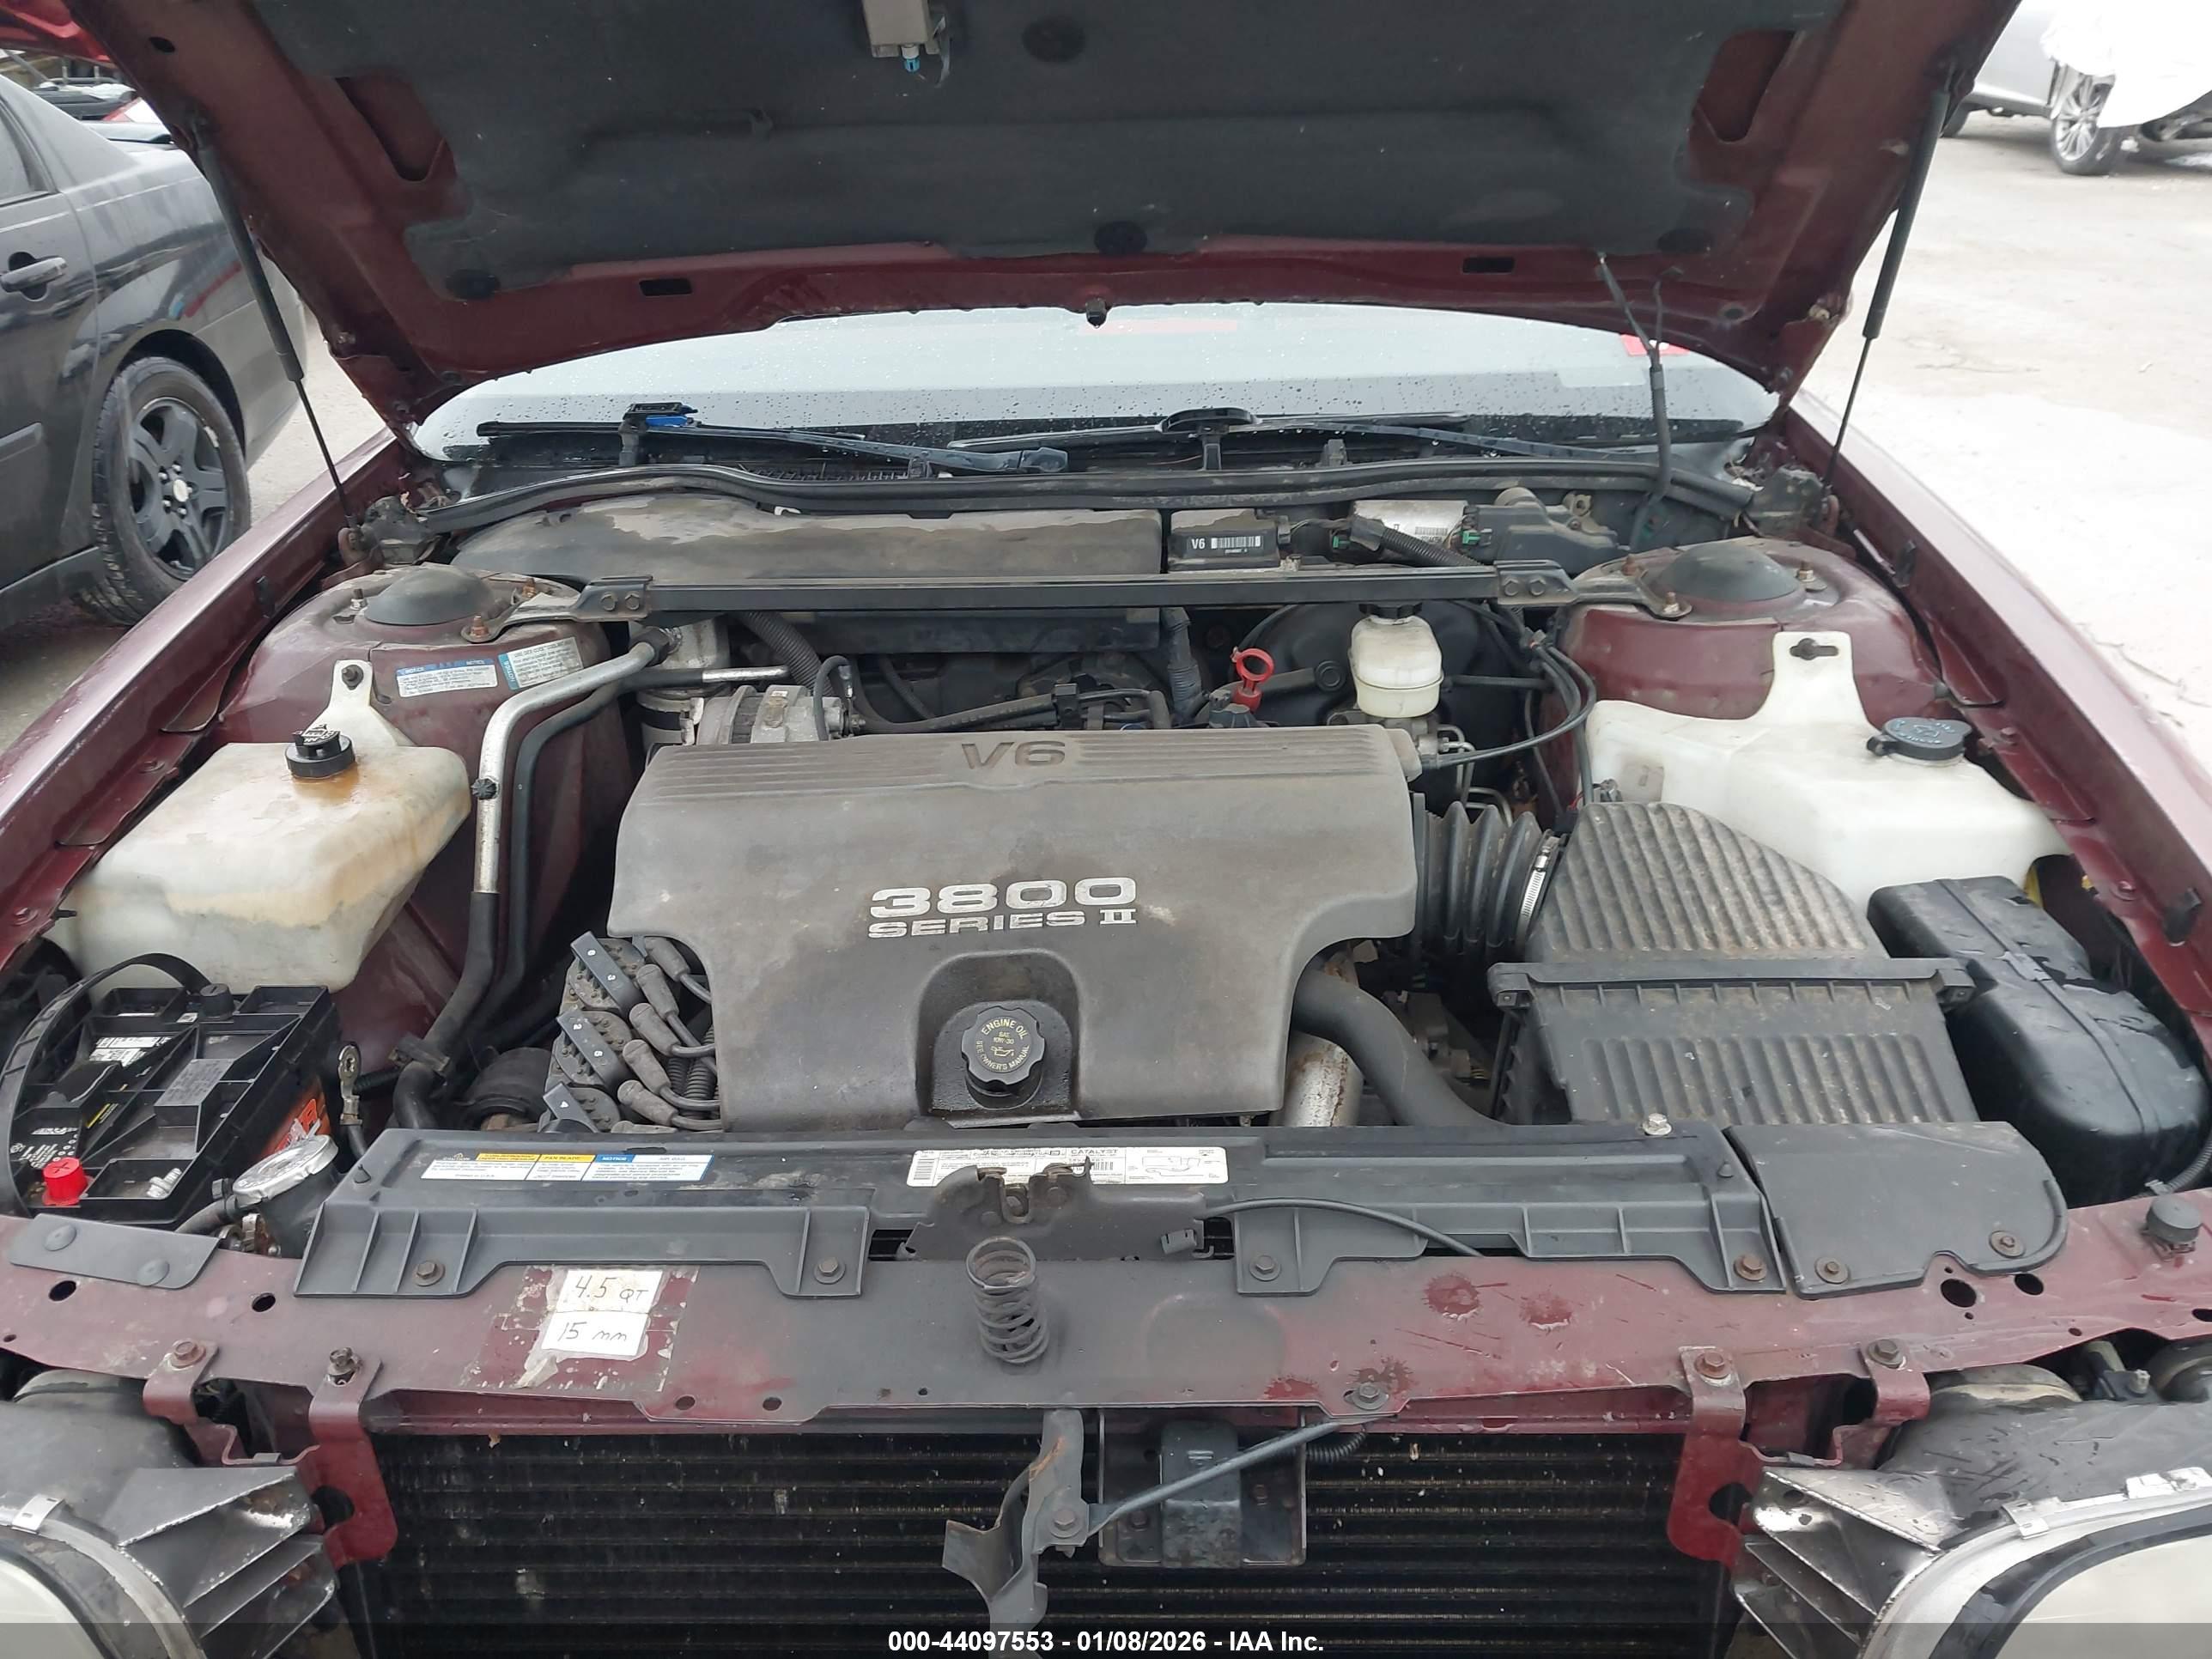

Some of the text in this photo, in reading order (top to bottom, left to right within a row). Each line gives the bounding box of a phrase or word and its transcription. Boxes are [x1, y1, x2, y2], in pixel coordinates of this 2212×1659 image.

[1191, 538, 1206, 550] V6
[961, 740, 1066, 770] V6
[870, 877, 1137, 919] 3800
[867, 908, 1137, 939] SERIES II
[981, 1018, 1029, 1040] ENGINE OIL
[1008, 1045, 1030, 1069] MANUAL
[575, 1274, 649, 1304] 4.5 QT
[557, 1322, 628, 1342] 15 mm
